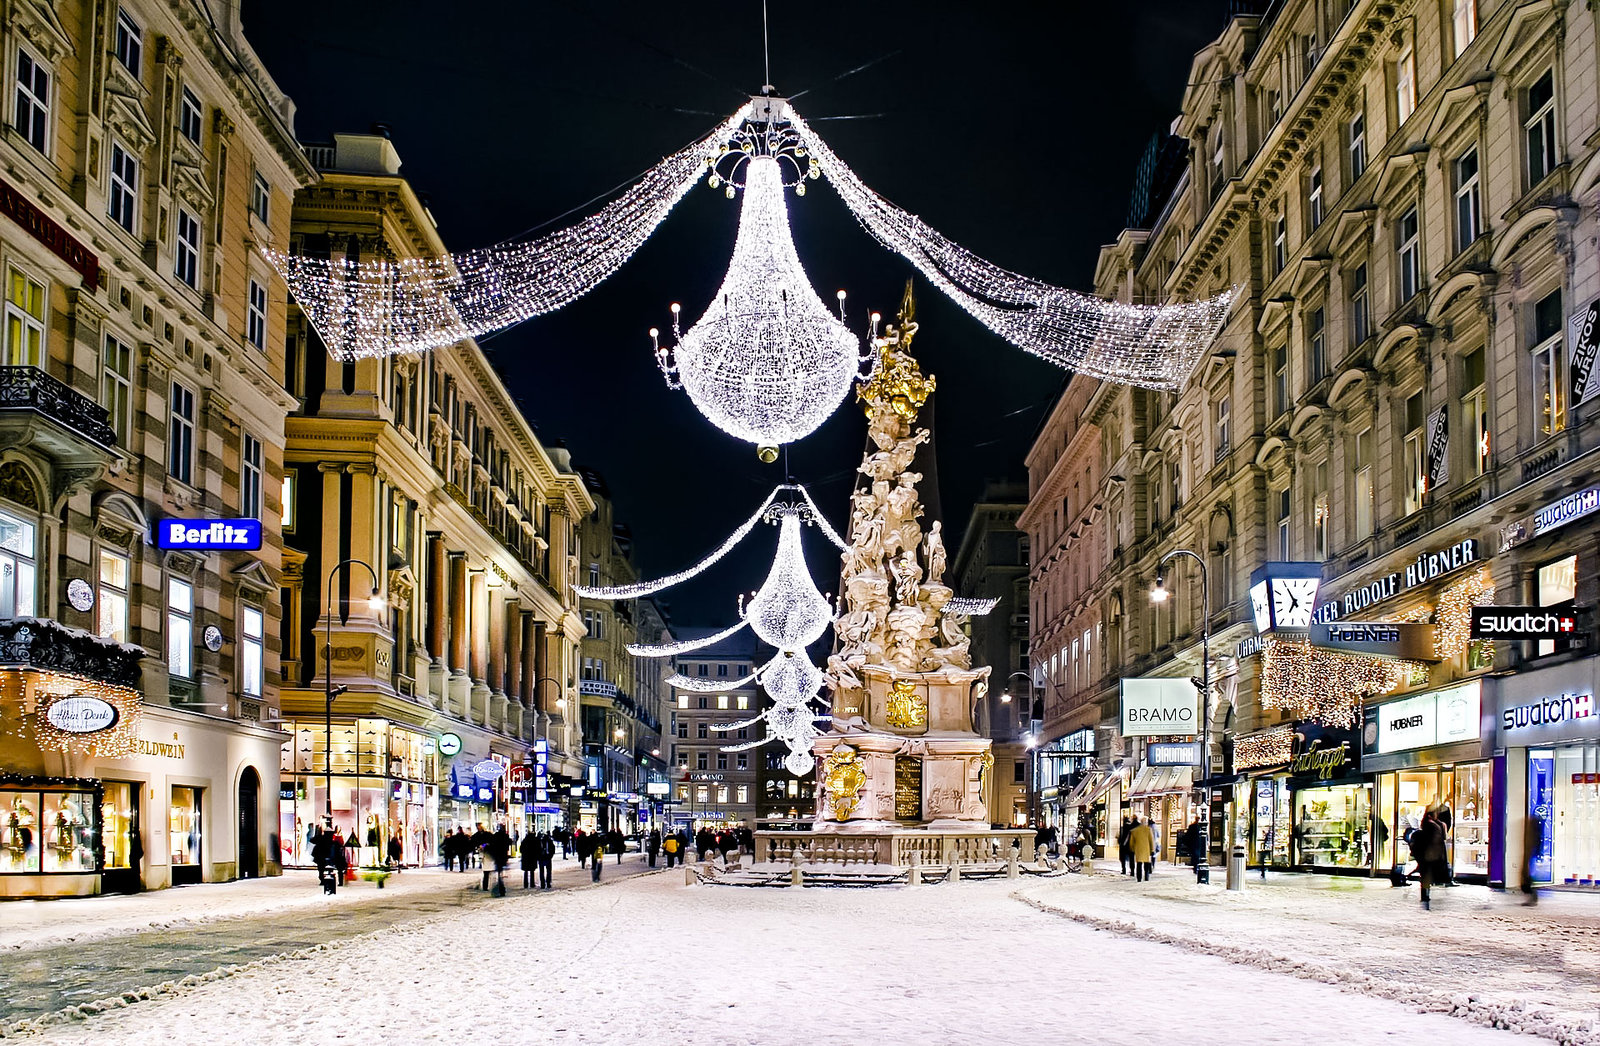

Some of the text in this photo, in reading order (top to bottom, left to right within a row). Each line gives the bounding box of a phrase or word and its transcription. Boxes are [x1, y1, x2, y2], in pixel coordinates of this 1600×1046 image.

[1573, 309, 1597, 368] ZIKOS
[1574, 343, 1596, 395] FURS
[1430, 412, 1446, 459] ZIKOS
[1431, 433, 1448, 480] PELZE
[169, 522, 248, 544] Berlitz
[1344, 573, 1397, 614] RUDOLF
[1406, 539, 1473, 588] HÜBNER
[1479, 613, 1559, 633] swatch
[82, 708, 109, 721] Denk
[1129, 707, 1192, 722] BRAMO
[1503, 694, 1573, 731] swatch
